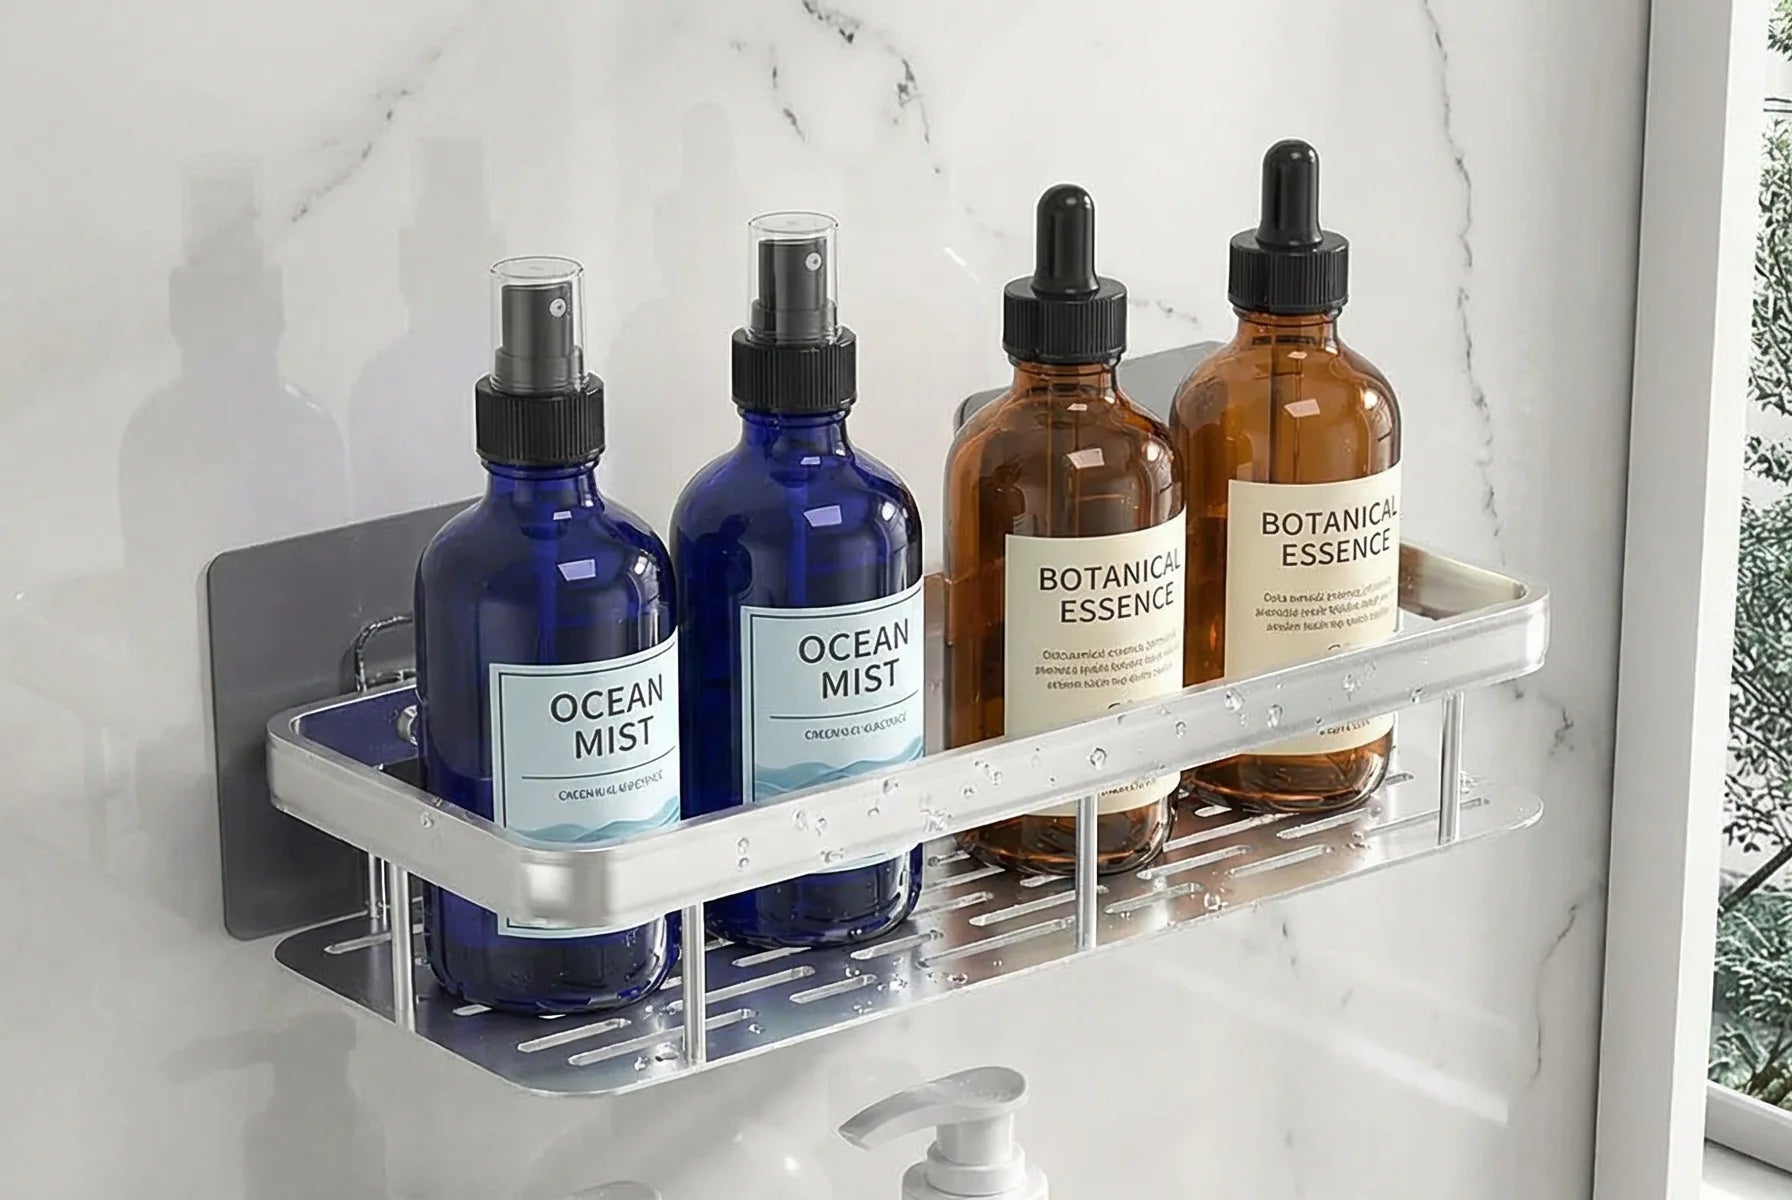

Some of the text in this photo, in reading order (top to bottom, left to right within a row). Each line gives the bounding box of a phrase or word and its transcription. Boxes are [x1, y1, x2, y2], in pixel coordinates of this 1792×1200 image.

[1262, 495, 1398, 536] BOTANICAL
[1039, 547, 1181, 591] BOTANICAL
[1282, 528, 1390, 567] ESSENCE
[1060, 581, 1174, 623] ESSENCE
[799, 618, 909, 664] OCEAN
[550, 674, 663, 723] OCEAN
[822, 658, 900, 699] MIST
[575, 715, 654, 759] MIST
